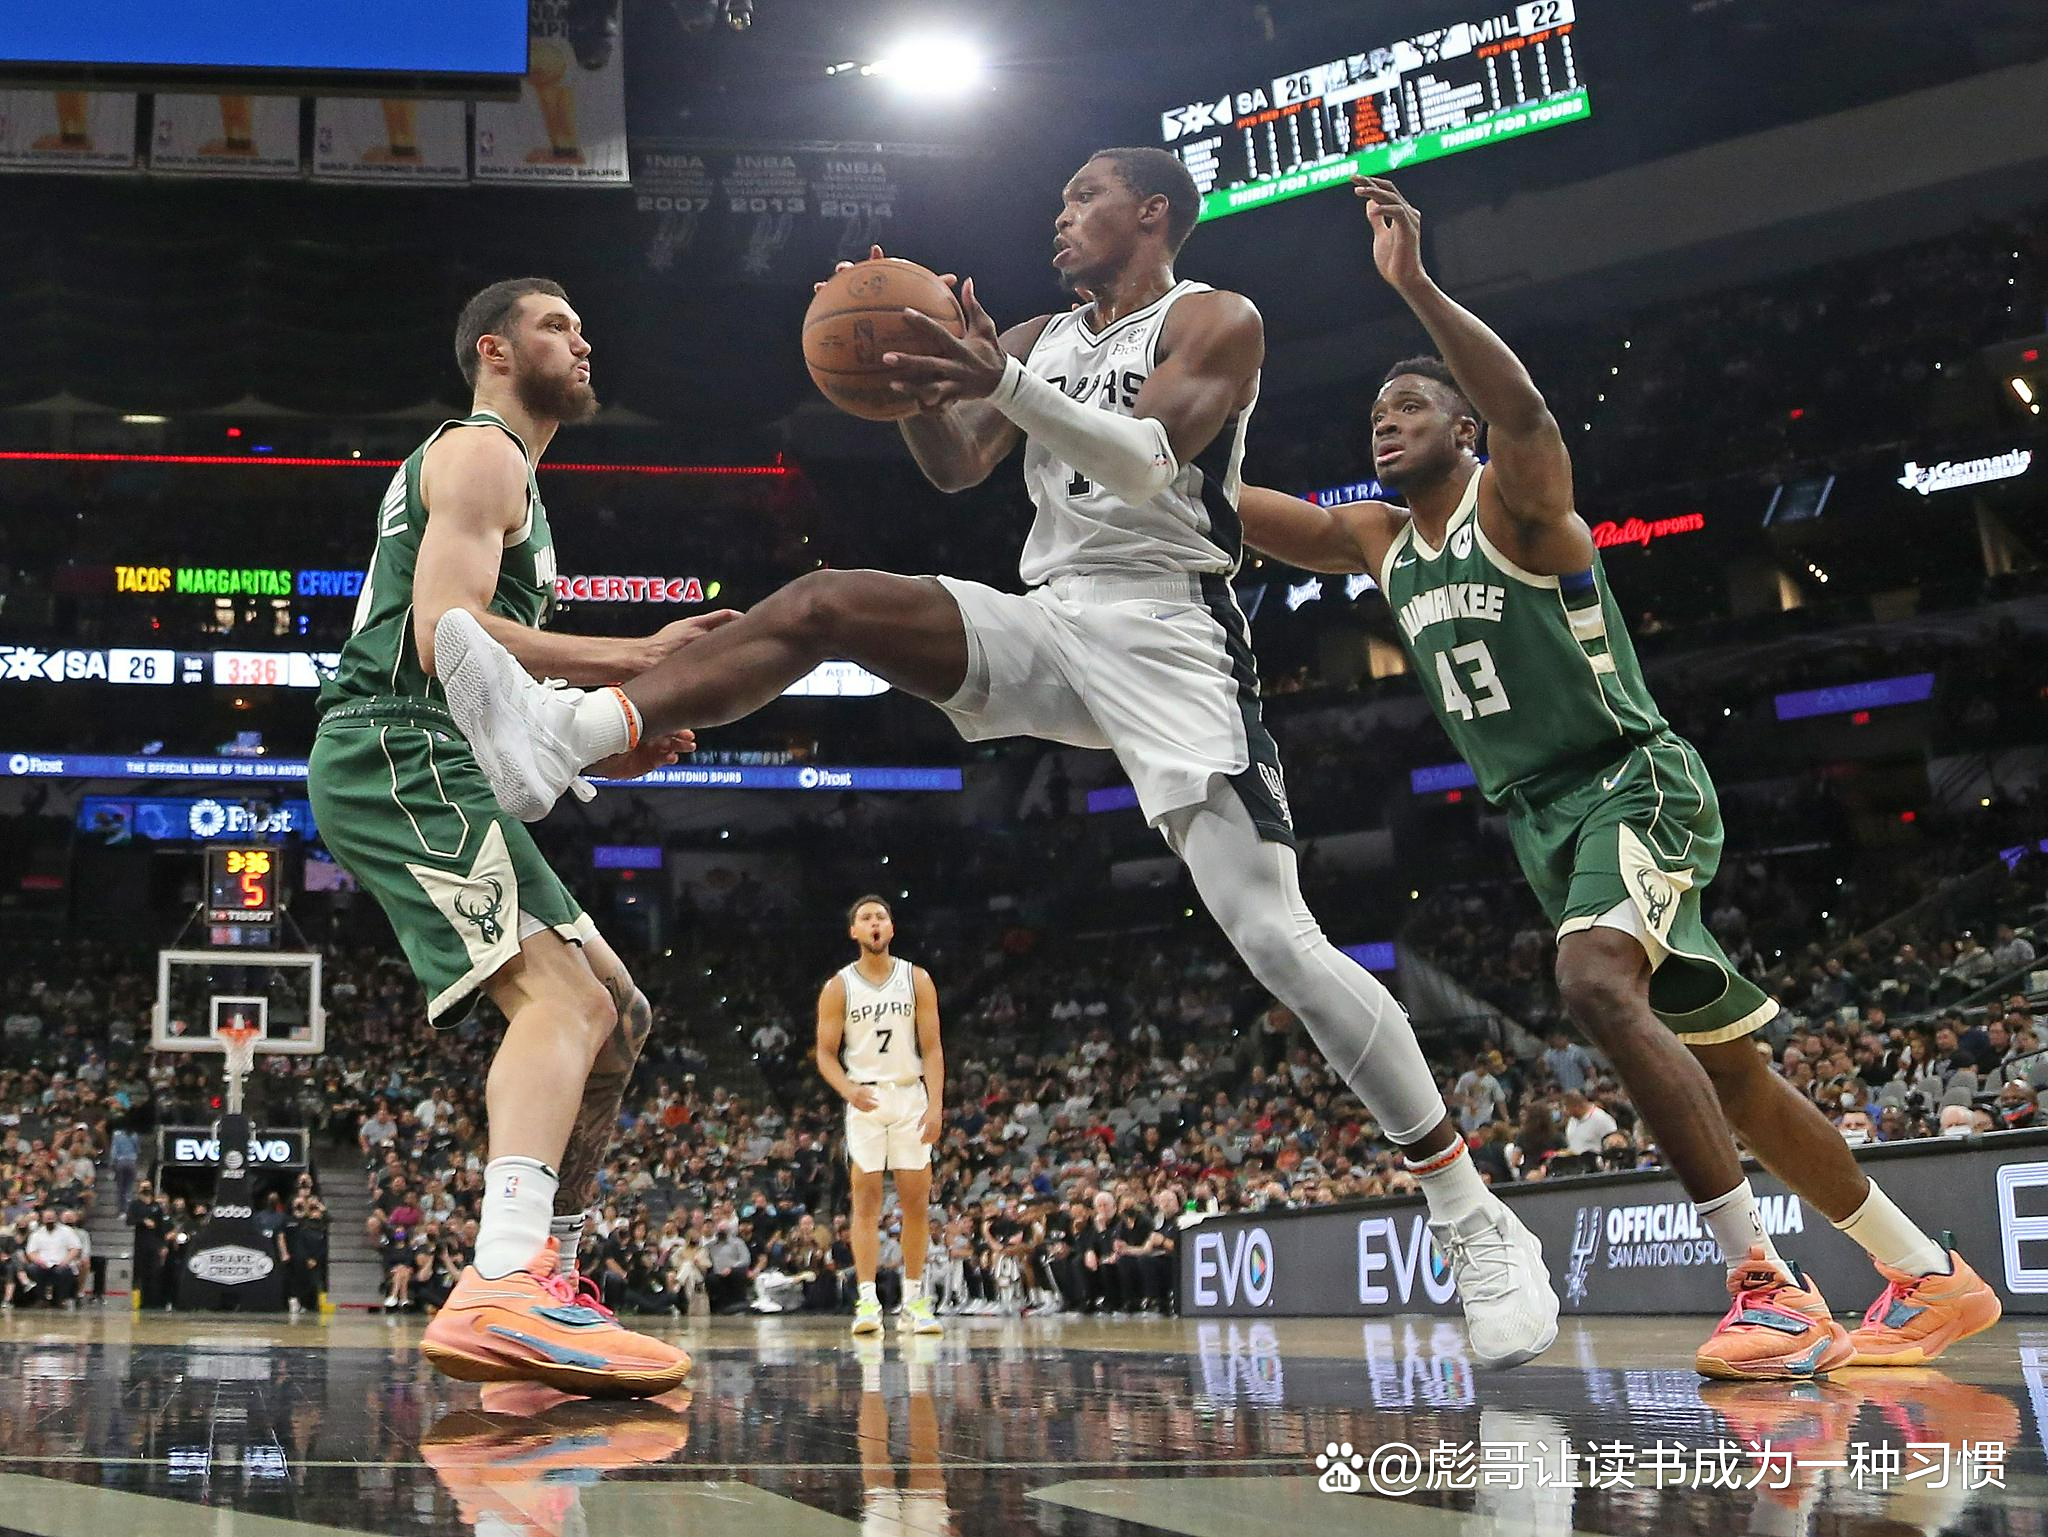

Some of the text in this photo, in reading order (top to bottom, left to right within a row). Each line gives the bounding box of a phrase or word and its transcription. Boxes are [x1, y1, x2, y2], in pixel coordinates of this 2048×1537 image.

[1236, 88, 1269, 115] SA
[1286, 75, 1312, 100] 26
[1470, 15, 1520, 46] MIL
[1532, 2, 1562, 28] 22
[1494, 114, 1527, 133] FOR
[1529, 98, 1583, 123] YOURS
[1277, 174, 1308, 193] FOR
[1311, 160, 1359, 184] YOURS
[637, 198, 710, 212] 2007
[730, 198, 807, 213] 2013
[820, 201, 892, 217] 2014
[1936, 449, 2032, 478] Germania
[1320, 481, 1383, 506] ULTRA
[1592, 513, 1704, 548] Bally SPORTS
[115, 567, 172, 592] TACOS
[176, 568, 292, 595] MARGARITAS
[64, 650, 156, 680] SA 26
[229, 658, 277, 684] 3:36
[1435, 640, 1511, 720] 43
[29, 758, 64, 773] Frost
[127, 761, 146, 774] THE
[147, 761, 190, 774] OFFICIAL
[191, 763, 218, 775] BANK
[645, 771, 666, 783] SAN
[668, 771, 709, 784] ANTONIO
[709, 772, 743, 784] SPURS
[818, 770, 852, 787] Frost
[227, 850, 271, 874] 3:36
[242, 873, 265, 906] 5
[227, 911, 275, 922] TISSOT
[851, 1001, 913, 1024] SPURS
[876, 1029, 893, 1054] 7
[213, 1204, 252, 1219] odoo
[1606, 1202, 1703, 1245] OFFICIAL
[1194, 1228, 1274, 1307] EVO
[1607, 1240, 1726, 1270] SAN ANTONIO SPU
